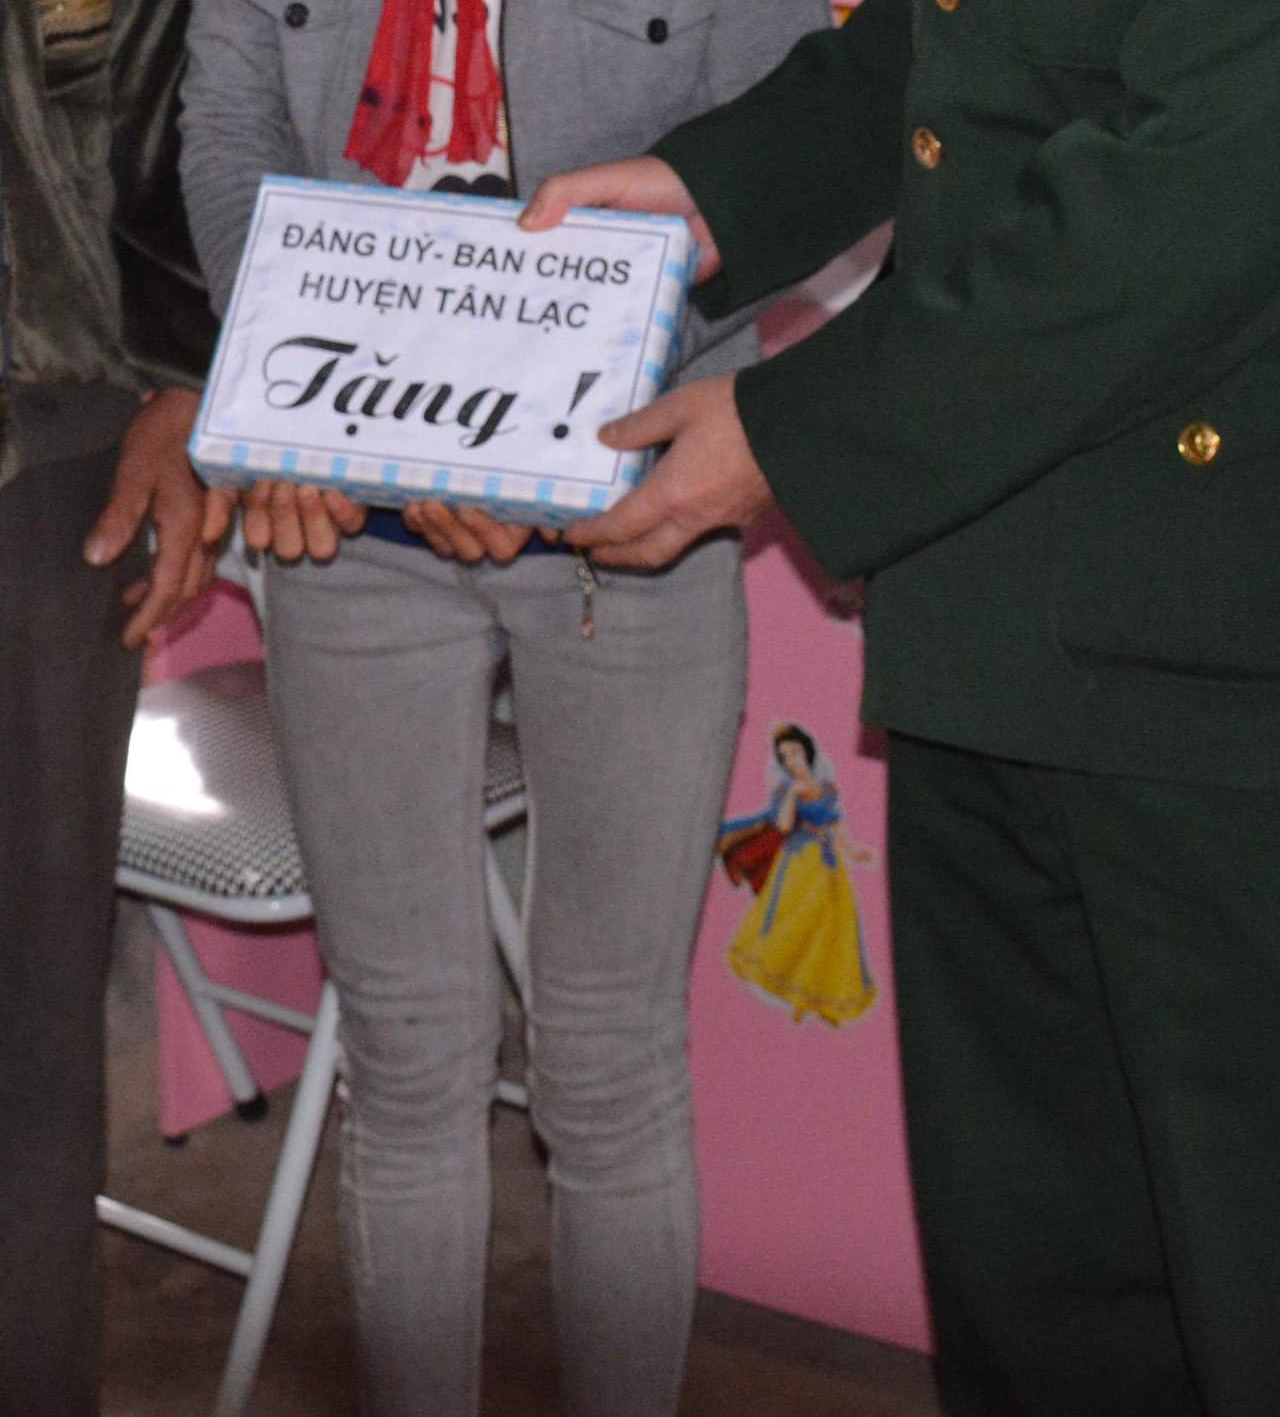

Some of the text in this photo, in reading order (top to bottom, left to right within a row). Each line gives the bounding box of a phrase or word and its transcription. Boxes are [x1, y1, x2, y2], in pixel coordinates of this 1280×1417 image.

[453, 242, 525, 275] BAN
[536, 252, 631, 285] CHQS
[298, 271, 590, 334] HUYỆN TÂN LẠC
[262, 335, 520, 448] Tặng
